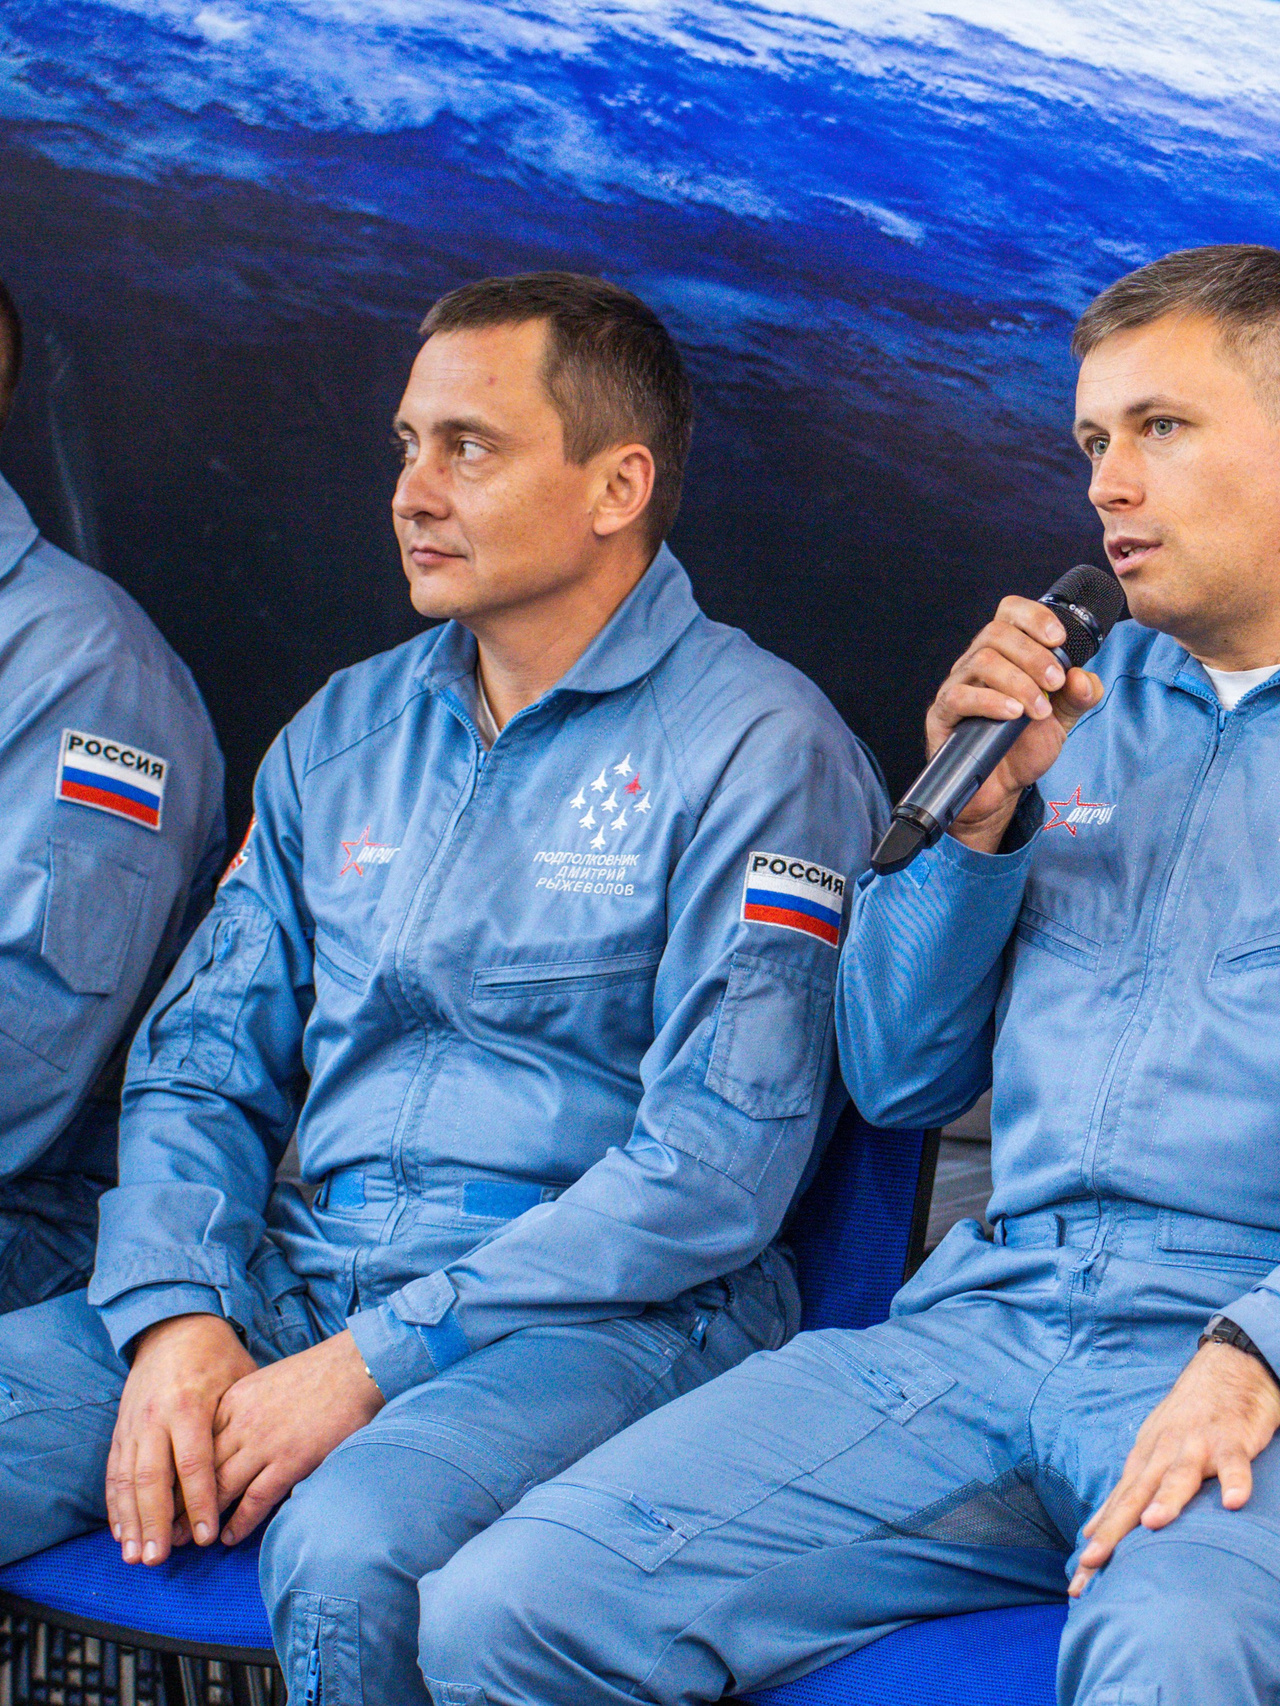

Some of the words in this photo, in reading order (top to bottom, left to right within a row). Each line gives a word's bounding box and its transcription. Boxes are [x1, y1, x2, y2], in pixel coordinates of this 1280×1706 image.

[69, 735, 163, 779] РОССИЯ
[533, 851, 639, 866] ПОДПОЛКОВНИК
[554, 865, 625, 881] ДМИТРИЙ
[752, 856, 844, 895] РОССИЯ
[535, 877, 634, 896] РЫЖЕВОЛОВ
